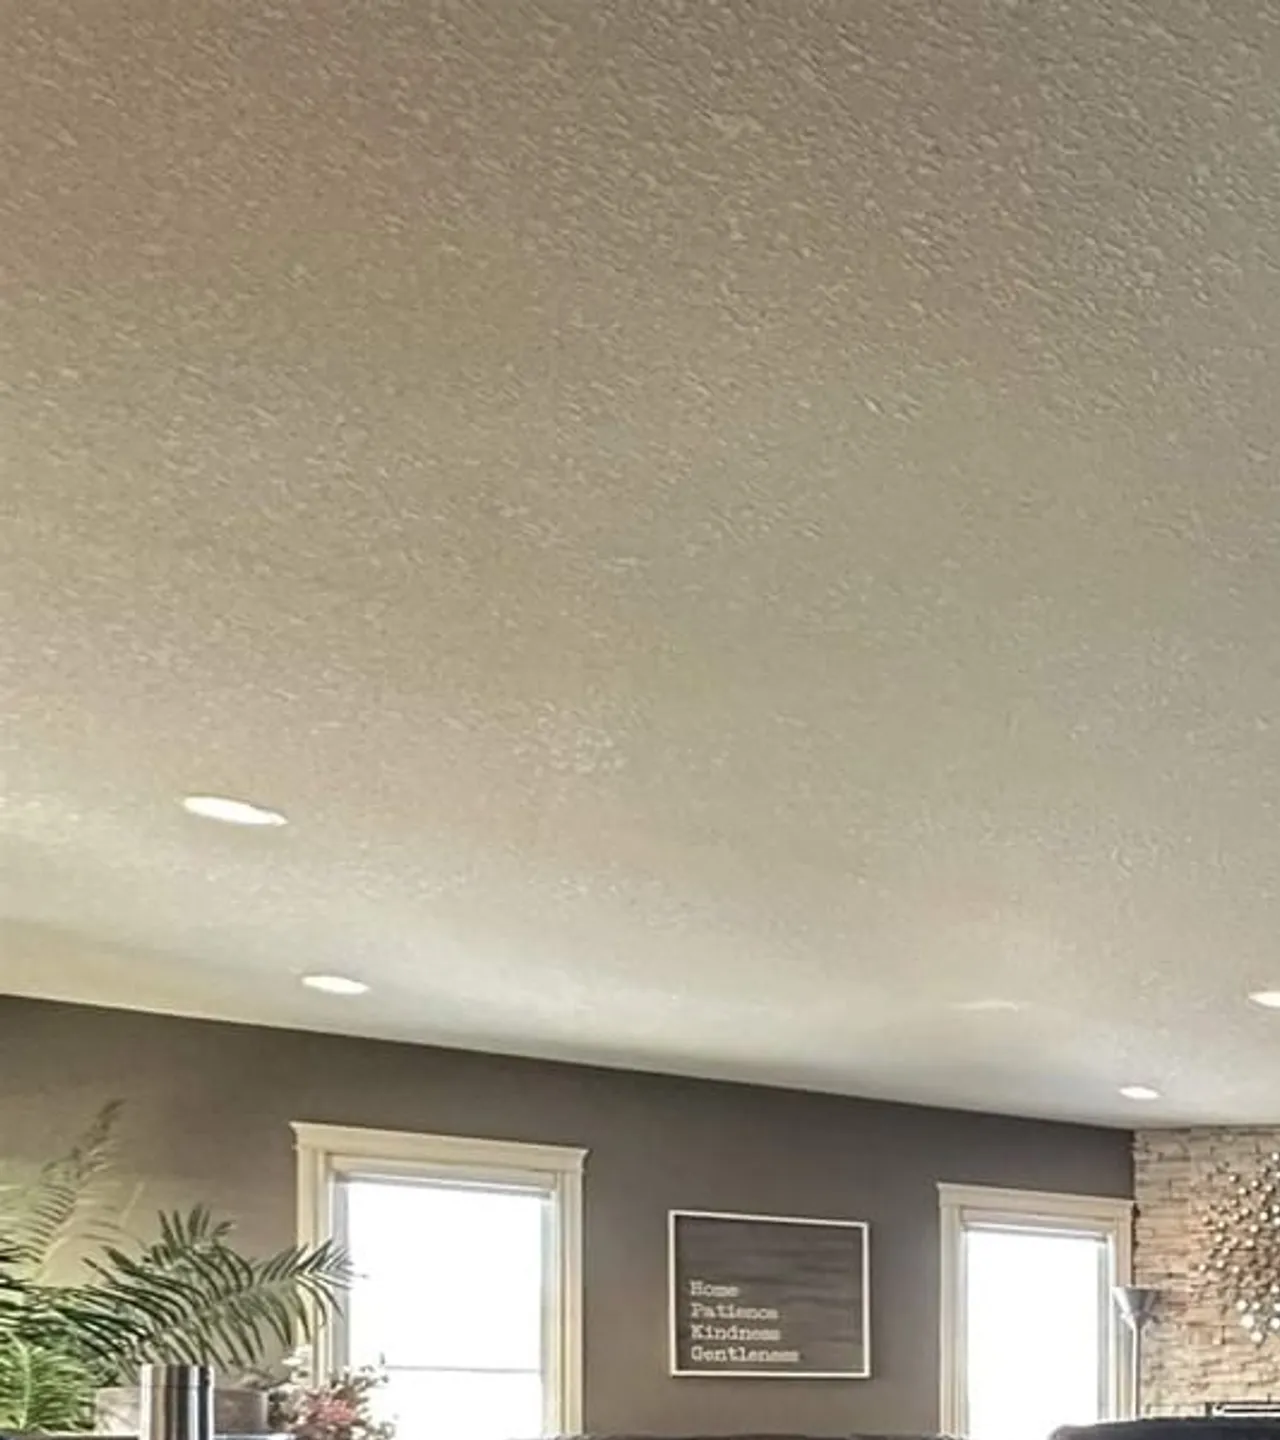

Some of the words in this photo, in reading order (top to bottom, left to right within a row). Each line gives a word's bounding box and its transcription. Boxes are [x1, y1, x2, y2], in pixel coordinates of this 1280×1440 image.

[689, 1280, 740, 1298] Home
[690, 1302, 779, 1320] Patience
[690, 1324, 781, 1341] Kindness
[690, 1346, 800, 1363] Gentleness
